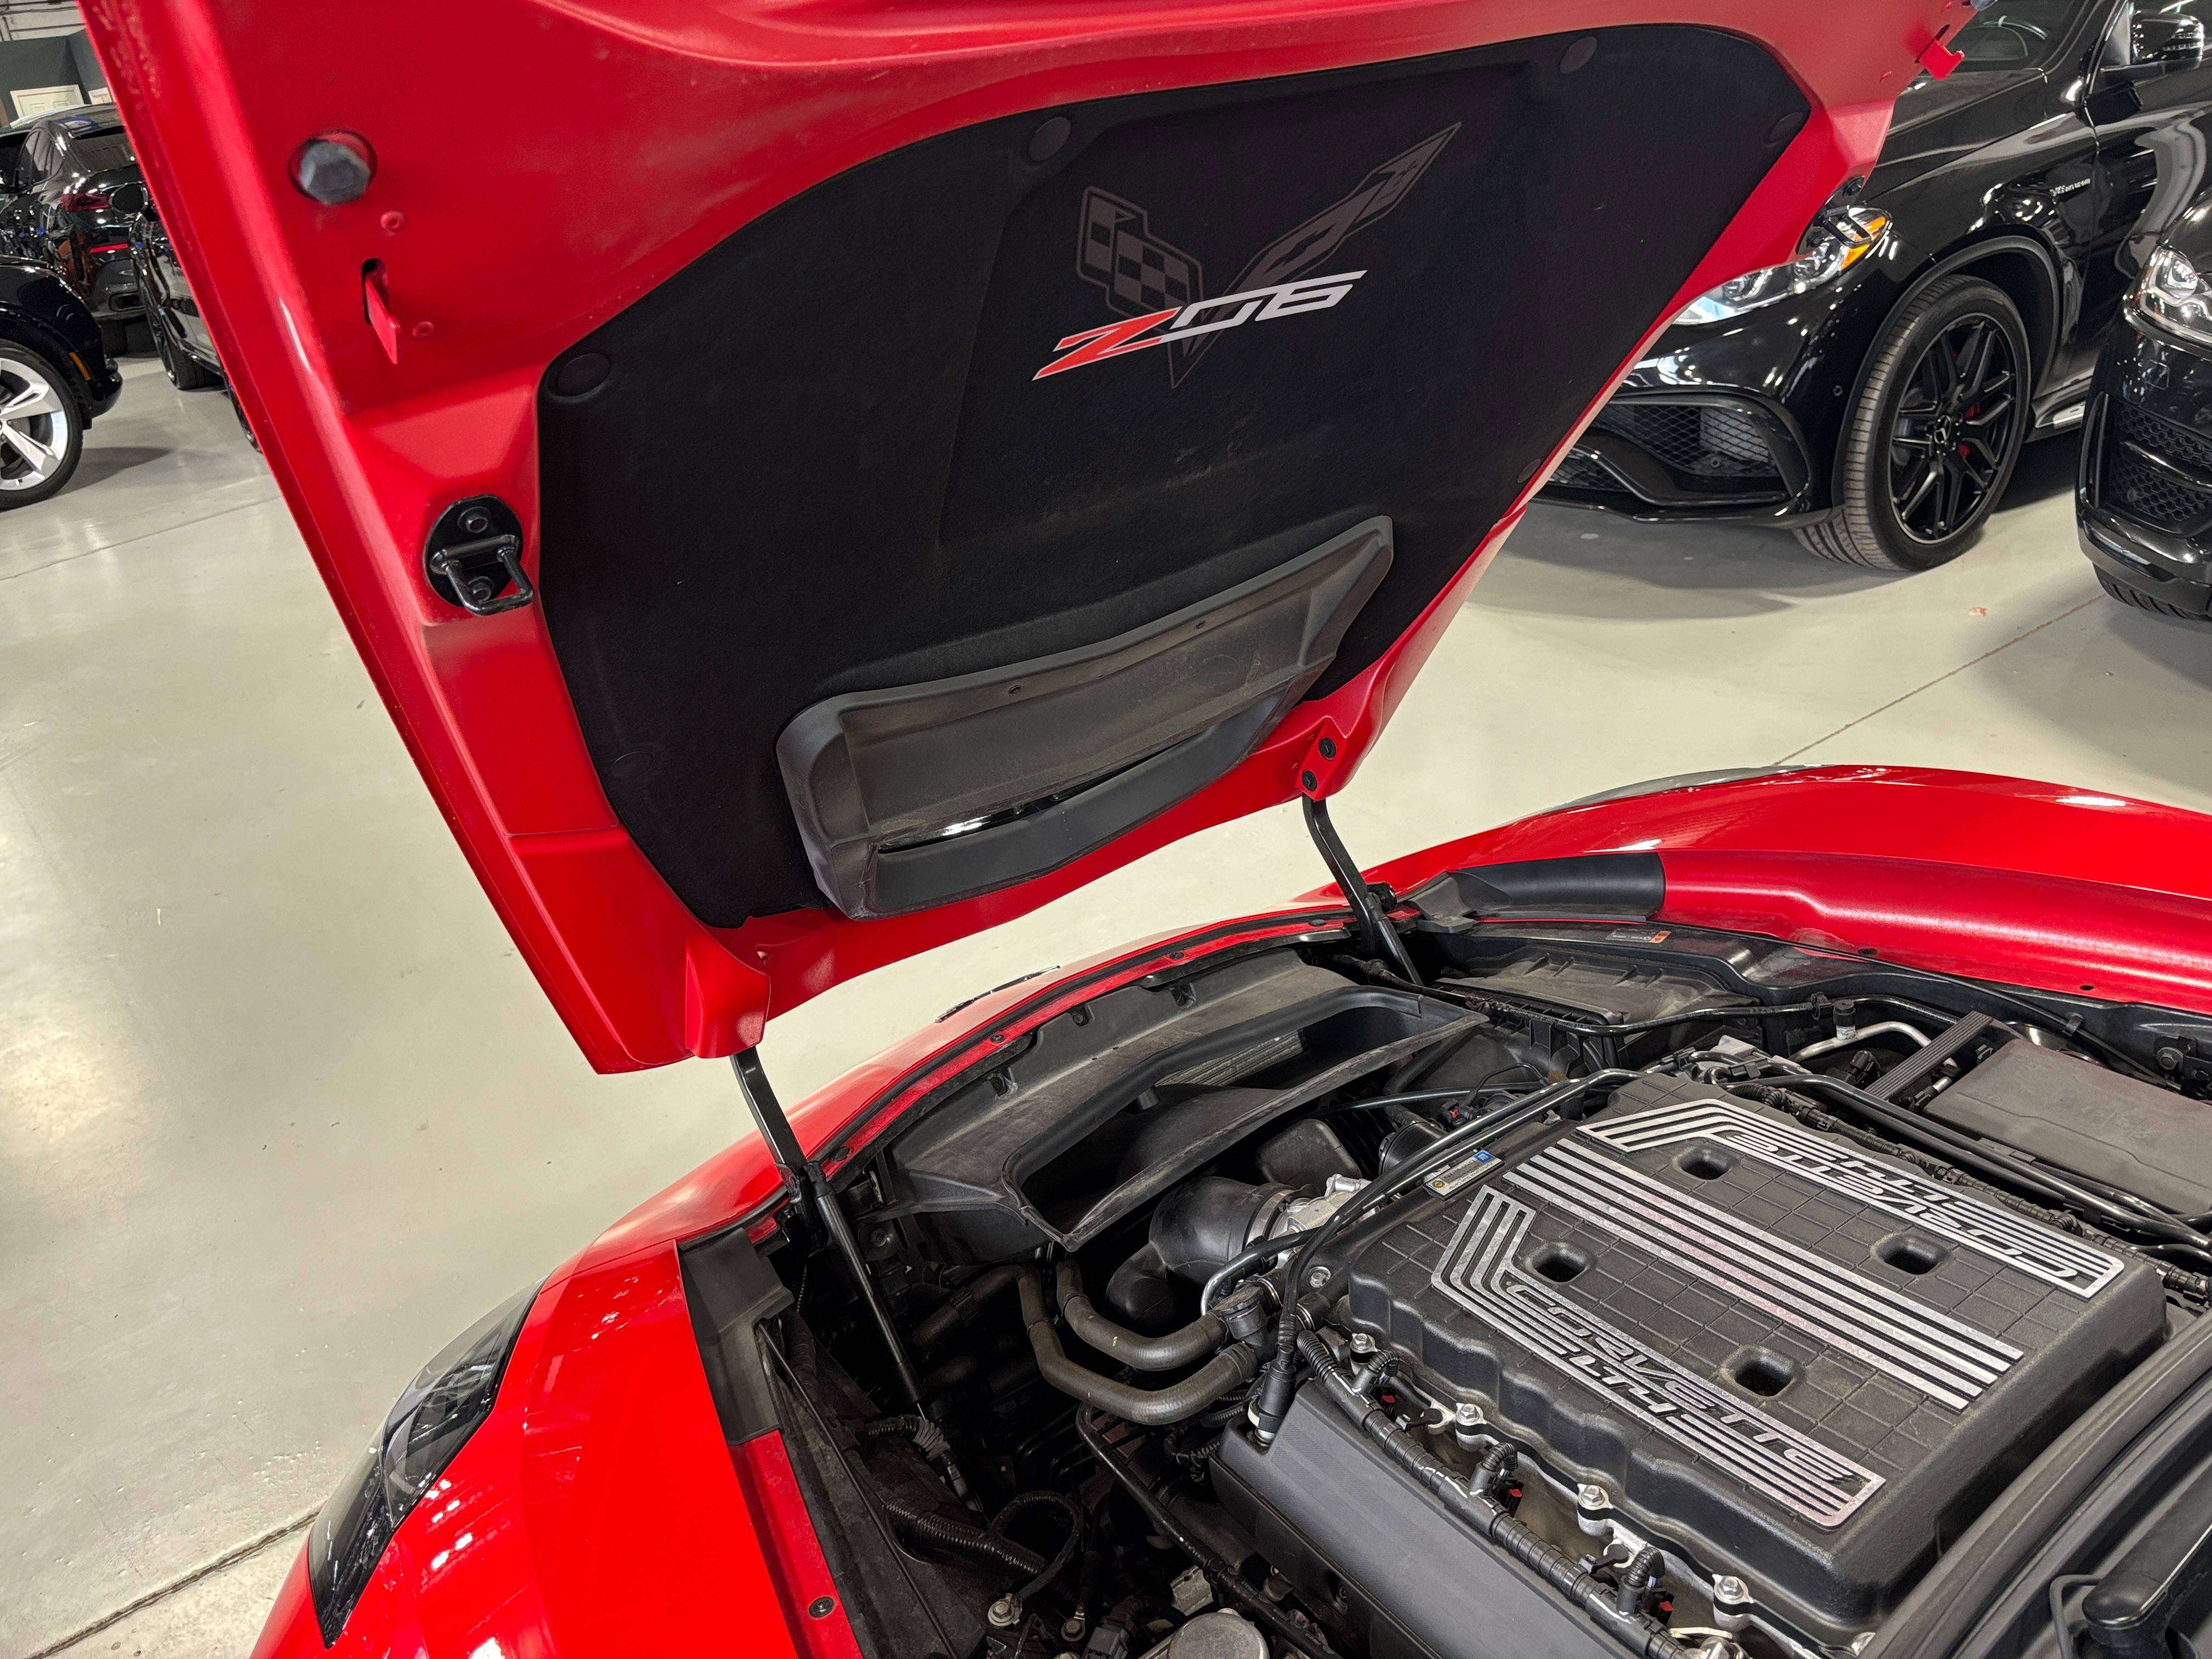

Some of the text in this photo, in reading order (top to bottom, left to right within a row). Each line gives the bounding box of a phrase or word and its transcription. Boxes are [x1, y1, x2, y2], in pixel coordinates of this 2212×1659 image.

[1032, 270, 1368, 381] Z06
[1726, 1135, 2078, 1279] CORVETTE
[1506, 1284, 1854, 1481] CORVETTE
